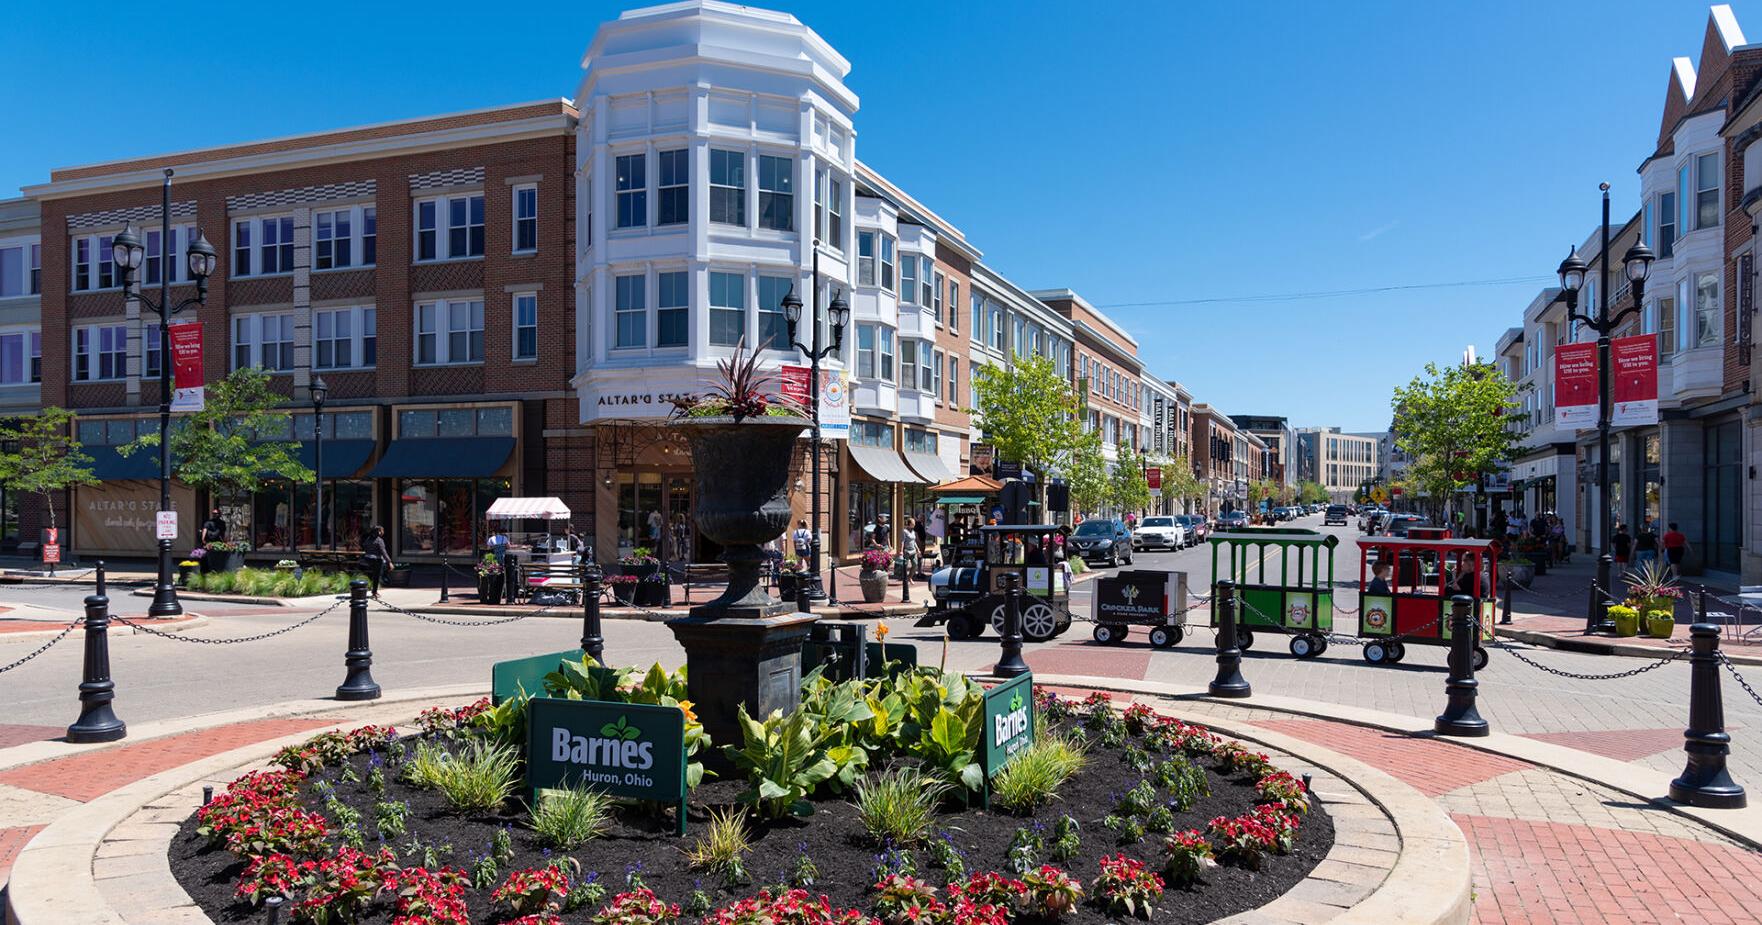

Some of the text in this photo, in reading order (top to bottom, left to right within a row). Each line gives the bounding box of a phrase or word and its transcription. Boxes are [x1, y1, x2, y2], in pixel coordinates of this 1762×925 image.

[598, 394, 652, 406] ALTAR'D
[142, 501, 177, 511] STAE
[1101, 603, 1160, 614] CROCKER PARK
[995, 705, 1028, 747] Barnes
[552, 727, 654, 770] Barnes
[583, 769, 653, 788] Huron, Ohio
